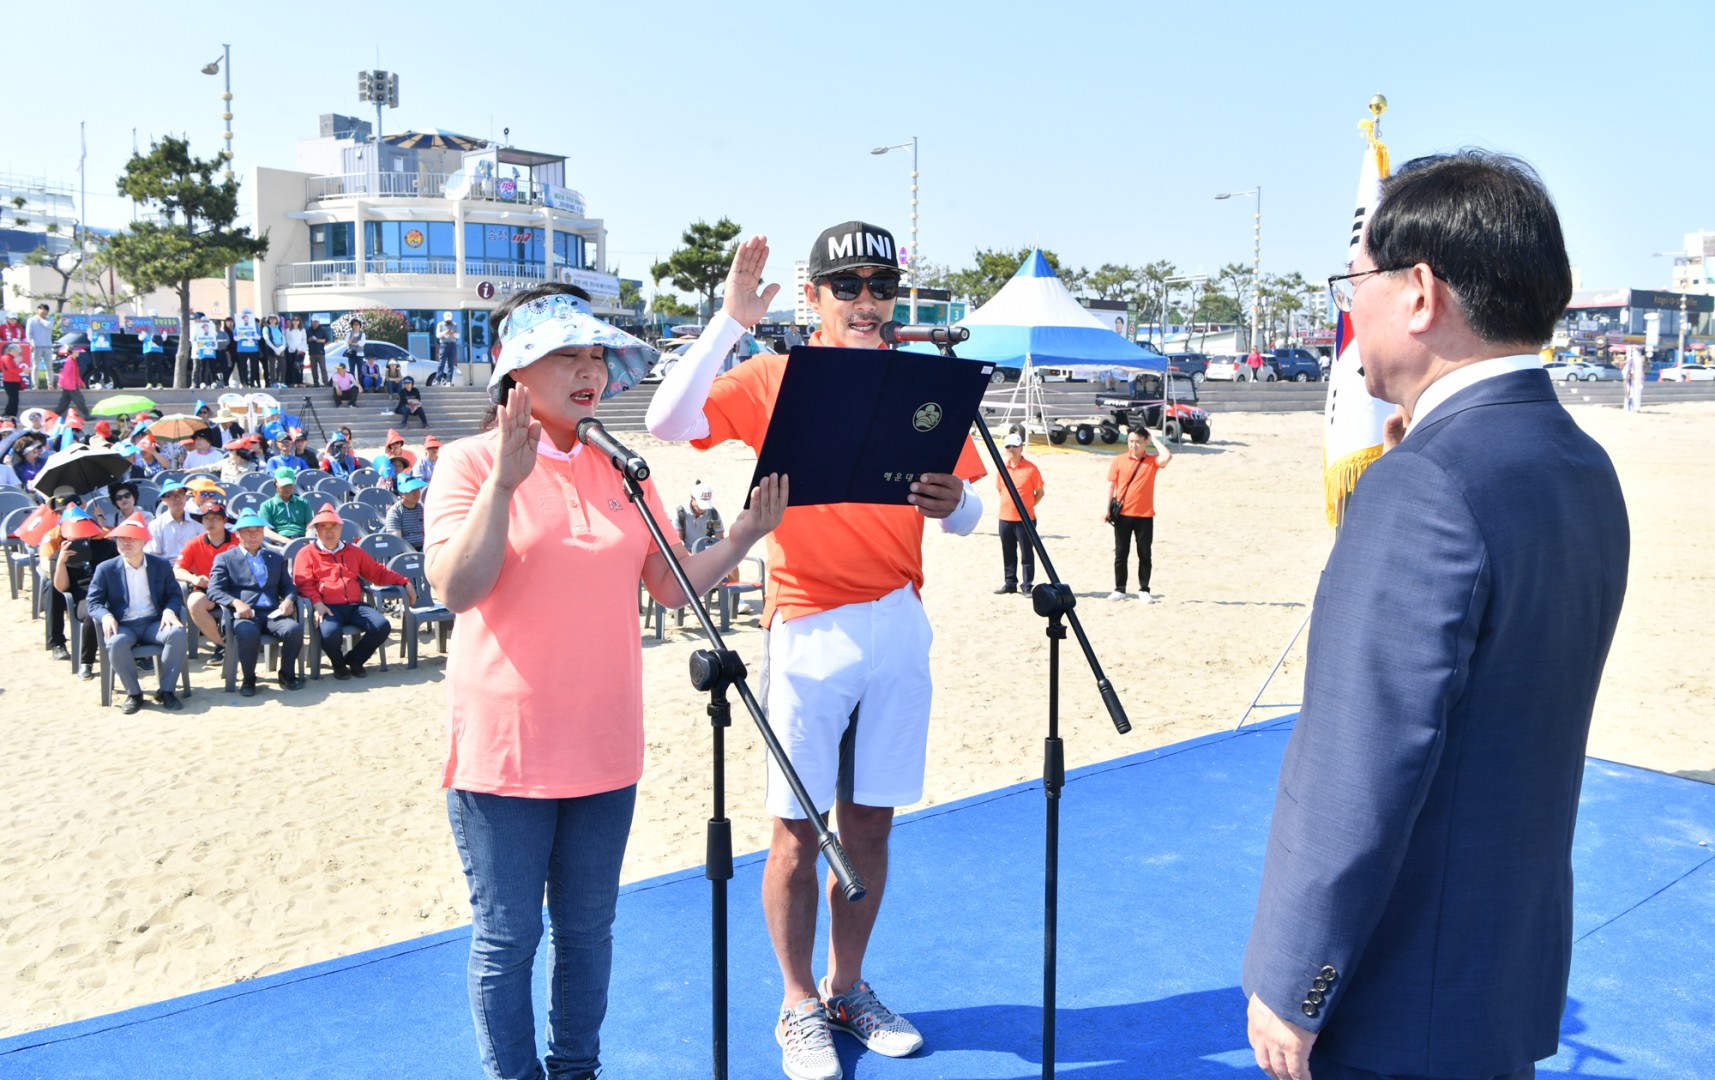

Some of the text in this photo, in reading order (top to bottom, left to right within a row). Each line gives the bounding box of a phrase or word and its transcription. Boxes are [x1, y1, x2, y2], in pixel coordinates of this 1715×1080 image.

[512, 231, 532, 242] 119
[828, 232, 892, 260] MINI
[884, 472, 921, 482] 해운대
